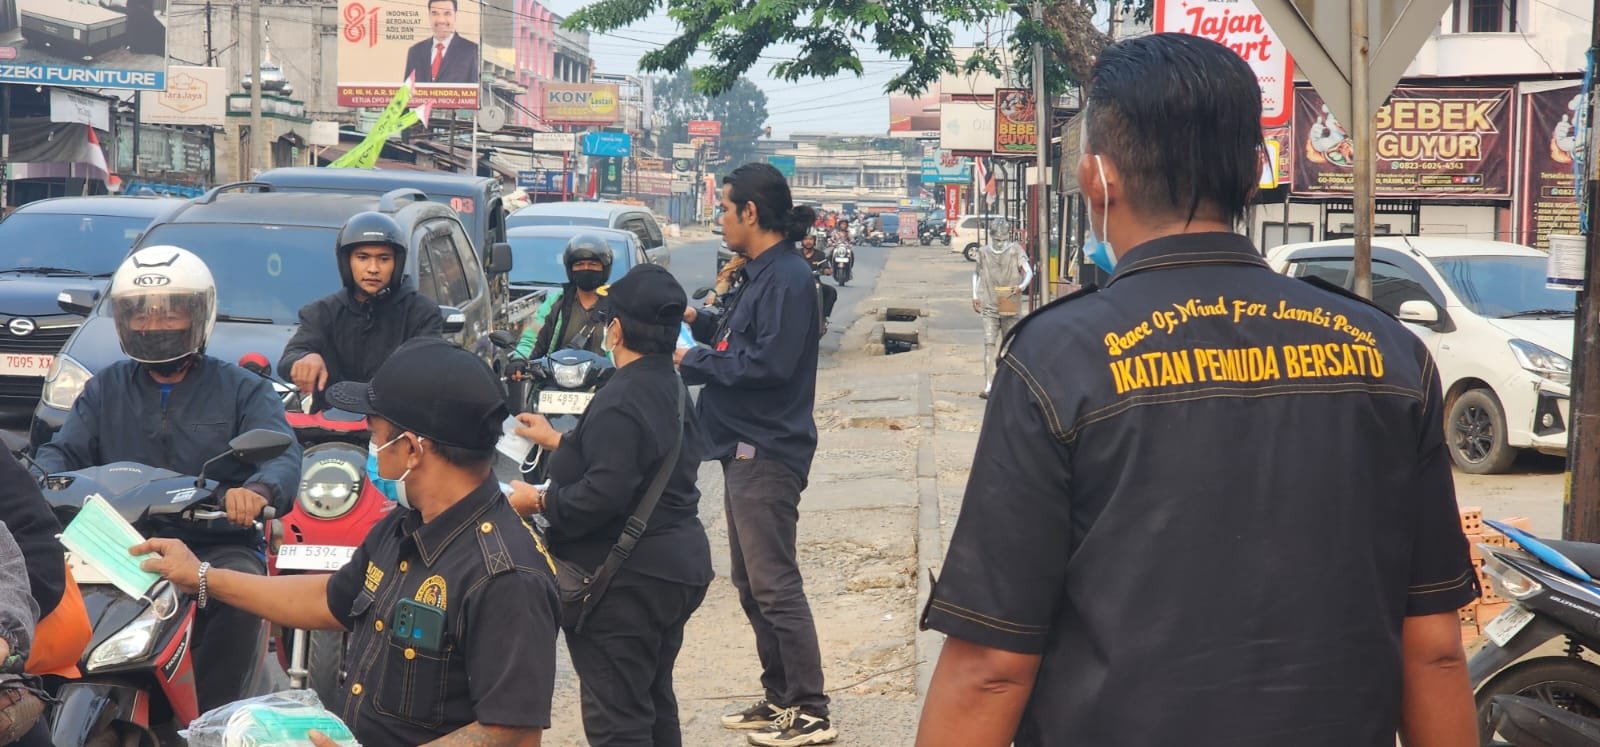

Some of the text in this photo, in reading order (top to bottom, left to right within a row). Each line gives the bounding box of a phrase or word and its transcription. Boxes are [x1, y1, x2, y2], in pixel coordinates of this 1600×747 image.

[343, 2, 381, 48] 81
[1186, 7, 1265, 42] Jajan
[46, 67, 156, 86] FURNITURE
[998, 134, 1037, 145] GUYU
[999, 123, 1036, 135] BEBE
[1377, 134, 1480, 158] GUYUR
[1104, 320, 1153, 356] Peace
[1173, 296, 1229, 323] Mind
[1232, 299, 1267, 322] For
[1273, 300, 1331, 328] Jambi
[1332, 314, 1377, 346] People
[1109, 343, 1385, 395] IKATAN PEMUDA BERSATU
[280, 546, 297, 557] BH
